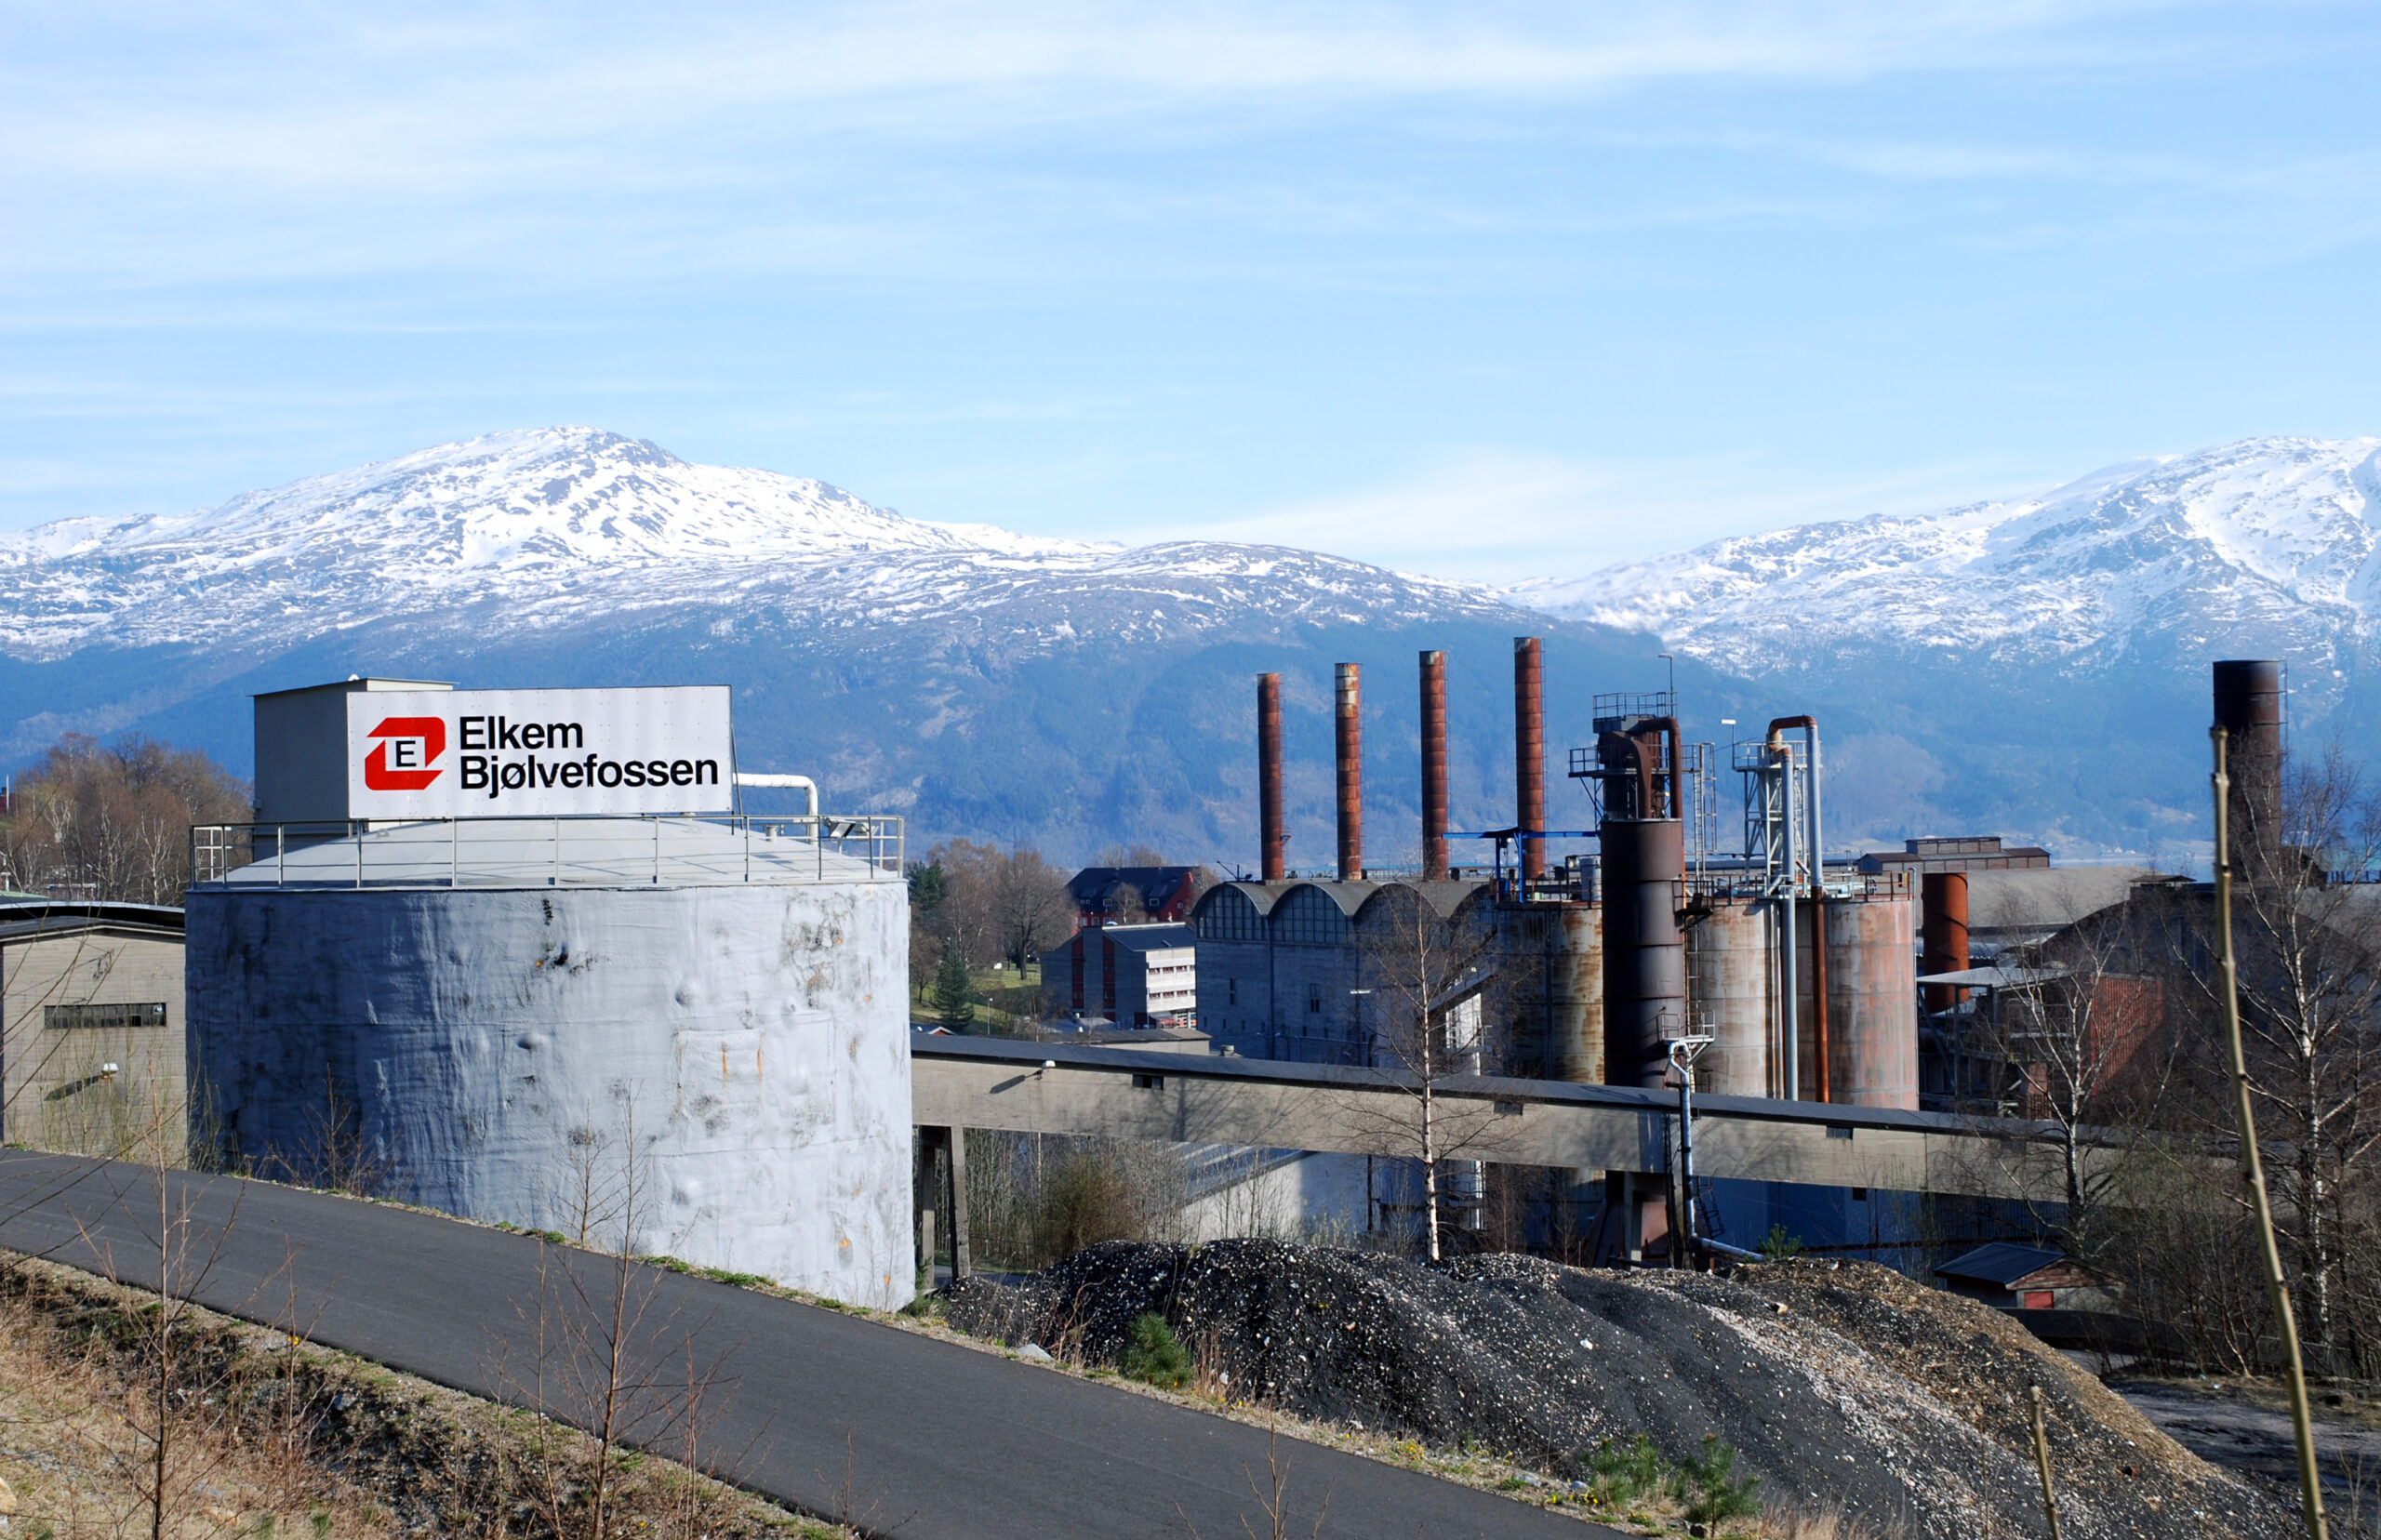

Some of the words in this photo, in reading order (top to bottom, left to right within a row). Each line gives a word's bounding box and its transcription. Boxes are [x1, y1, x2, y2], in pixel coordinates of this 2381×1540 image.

[459, 716, 583, 750] Elkem
[395, 740, 417, 767] E
[459, 754, 718, 799] Bjølvefossen
